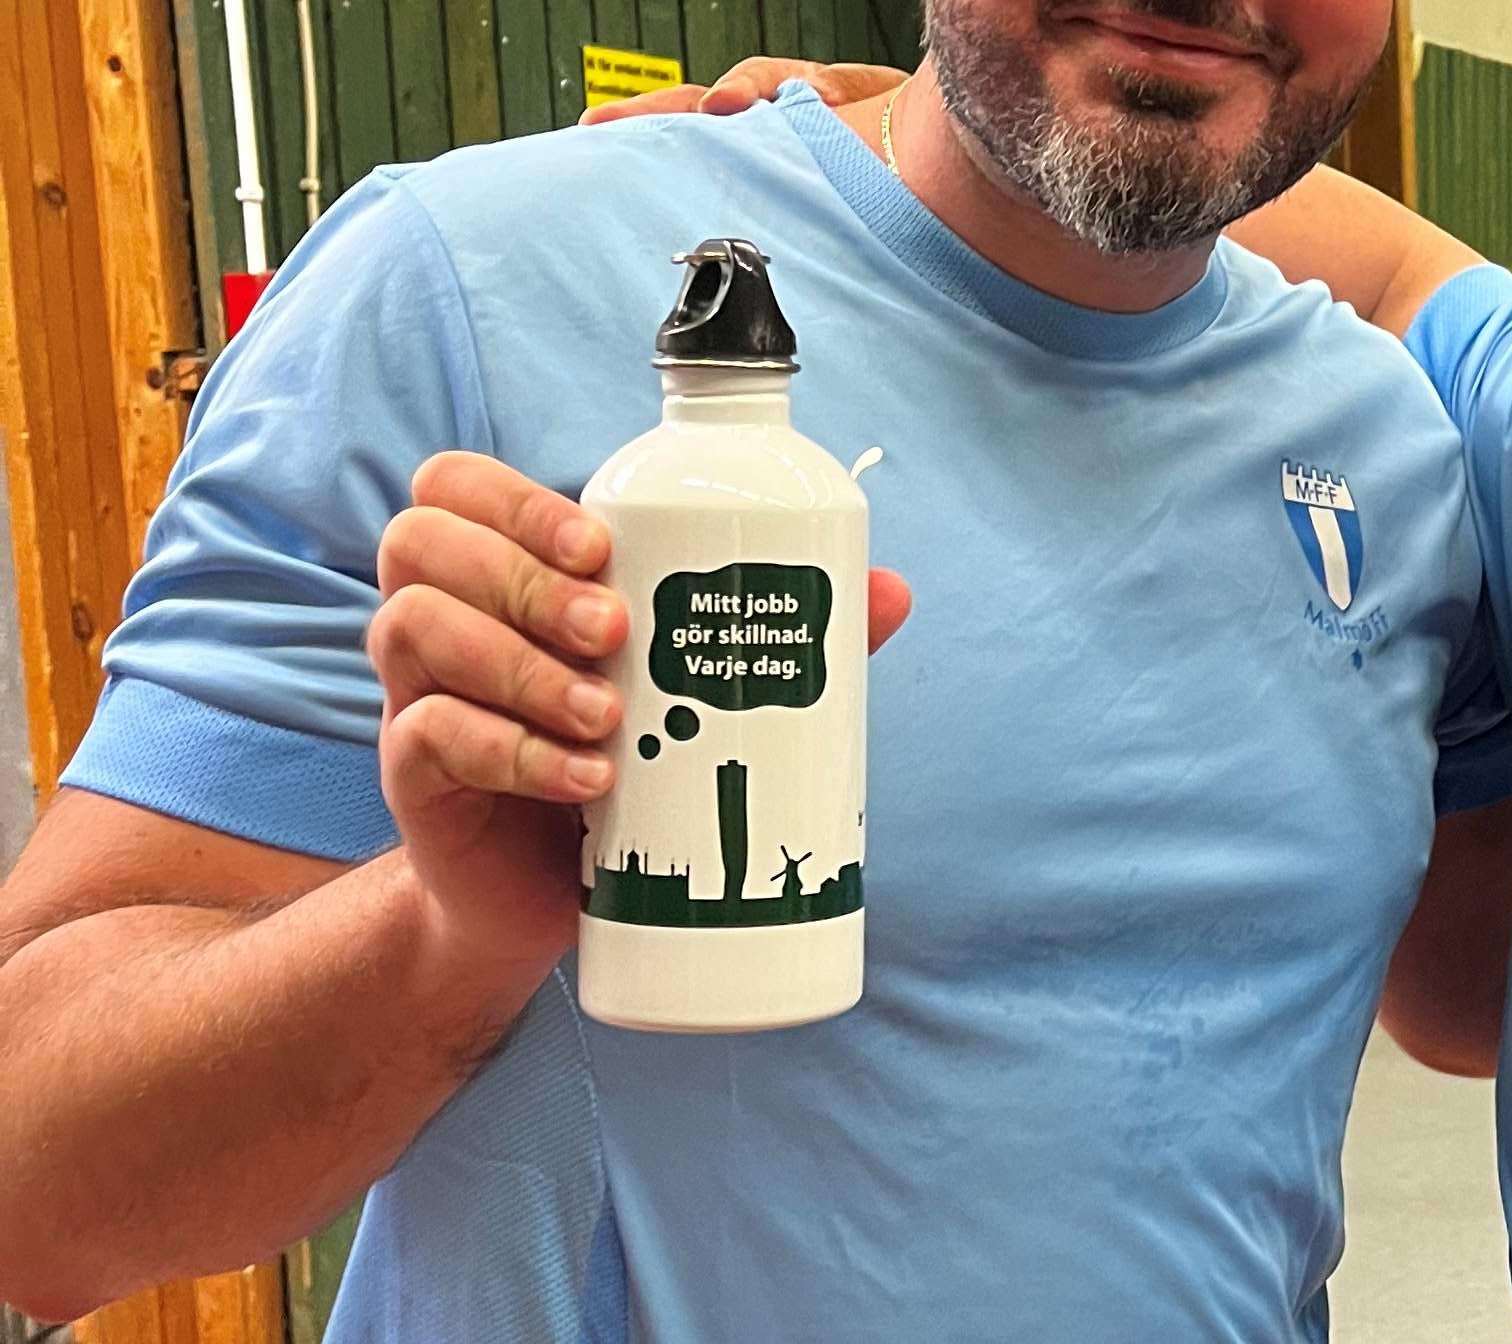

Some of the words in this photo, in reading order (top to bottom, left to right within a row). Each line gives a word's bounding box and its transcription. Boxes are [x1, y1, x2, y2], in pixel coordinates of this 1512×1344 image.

[690, 593, 741, 614] Mitt
[744, 593, 799, 618] jobb
[671, 624, 713, 648] gör
[718, 623, 814, 645] skillnad.
[684, 655, 748, 680] Varje
[752, 655, 802, 680] dag.
